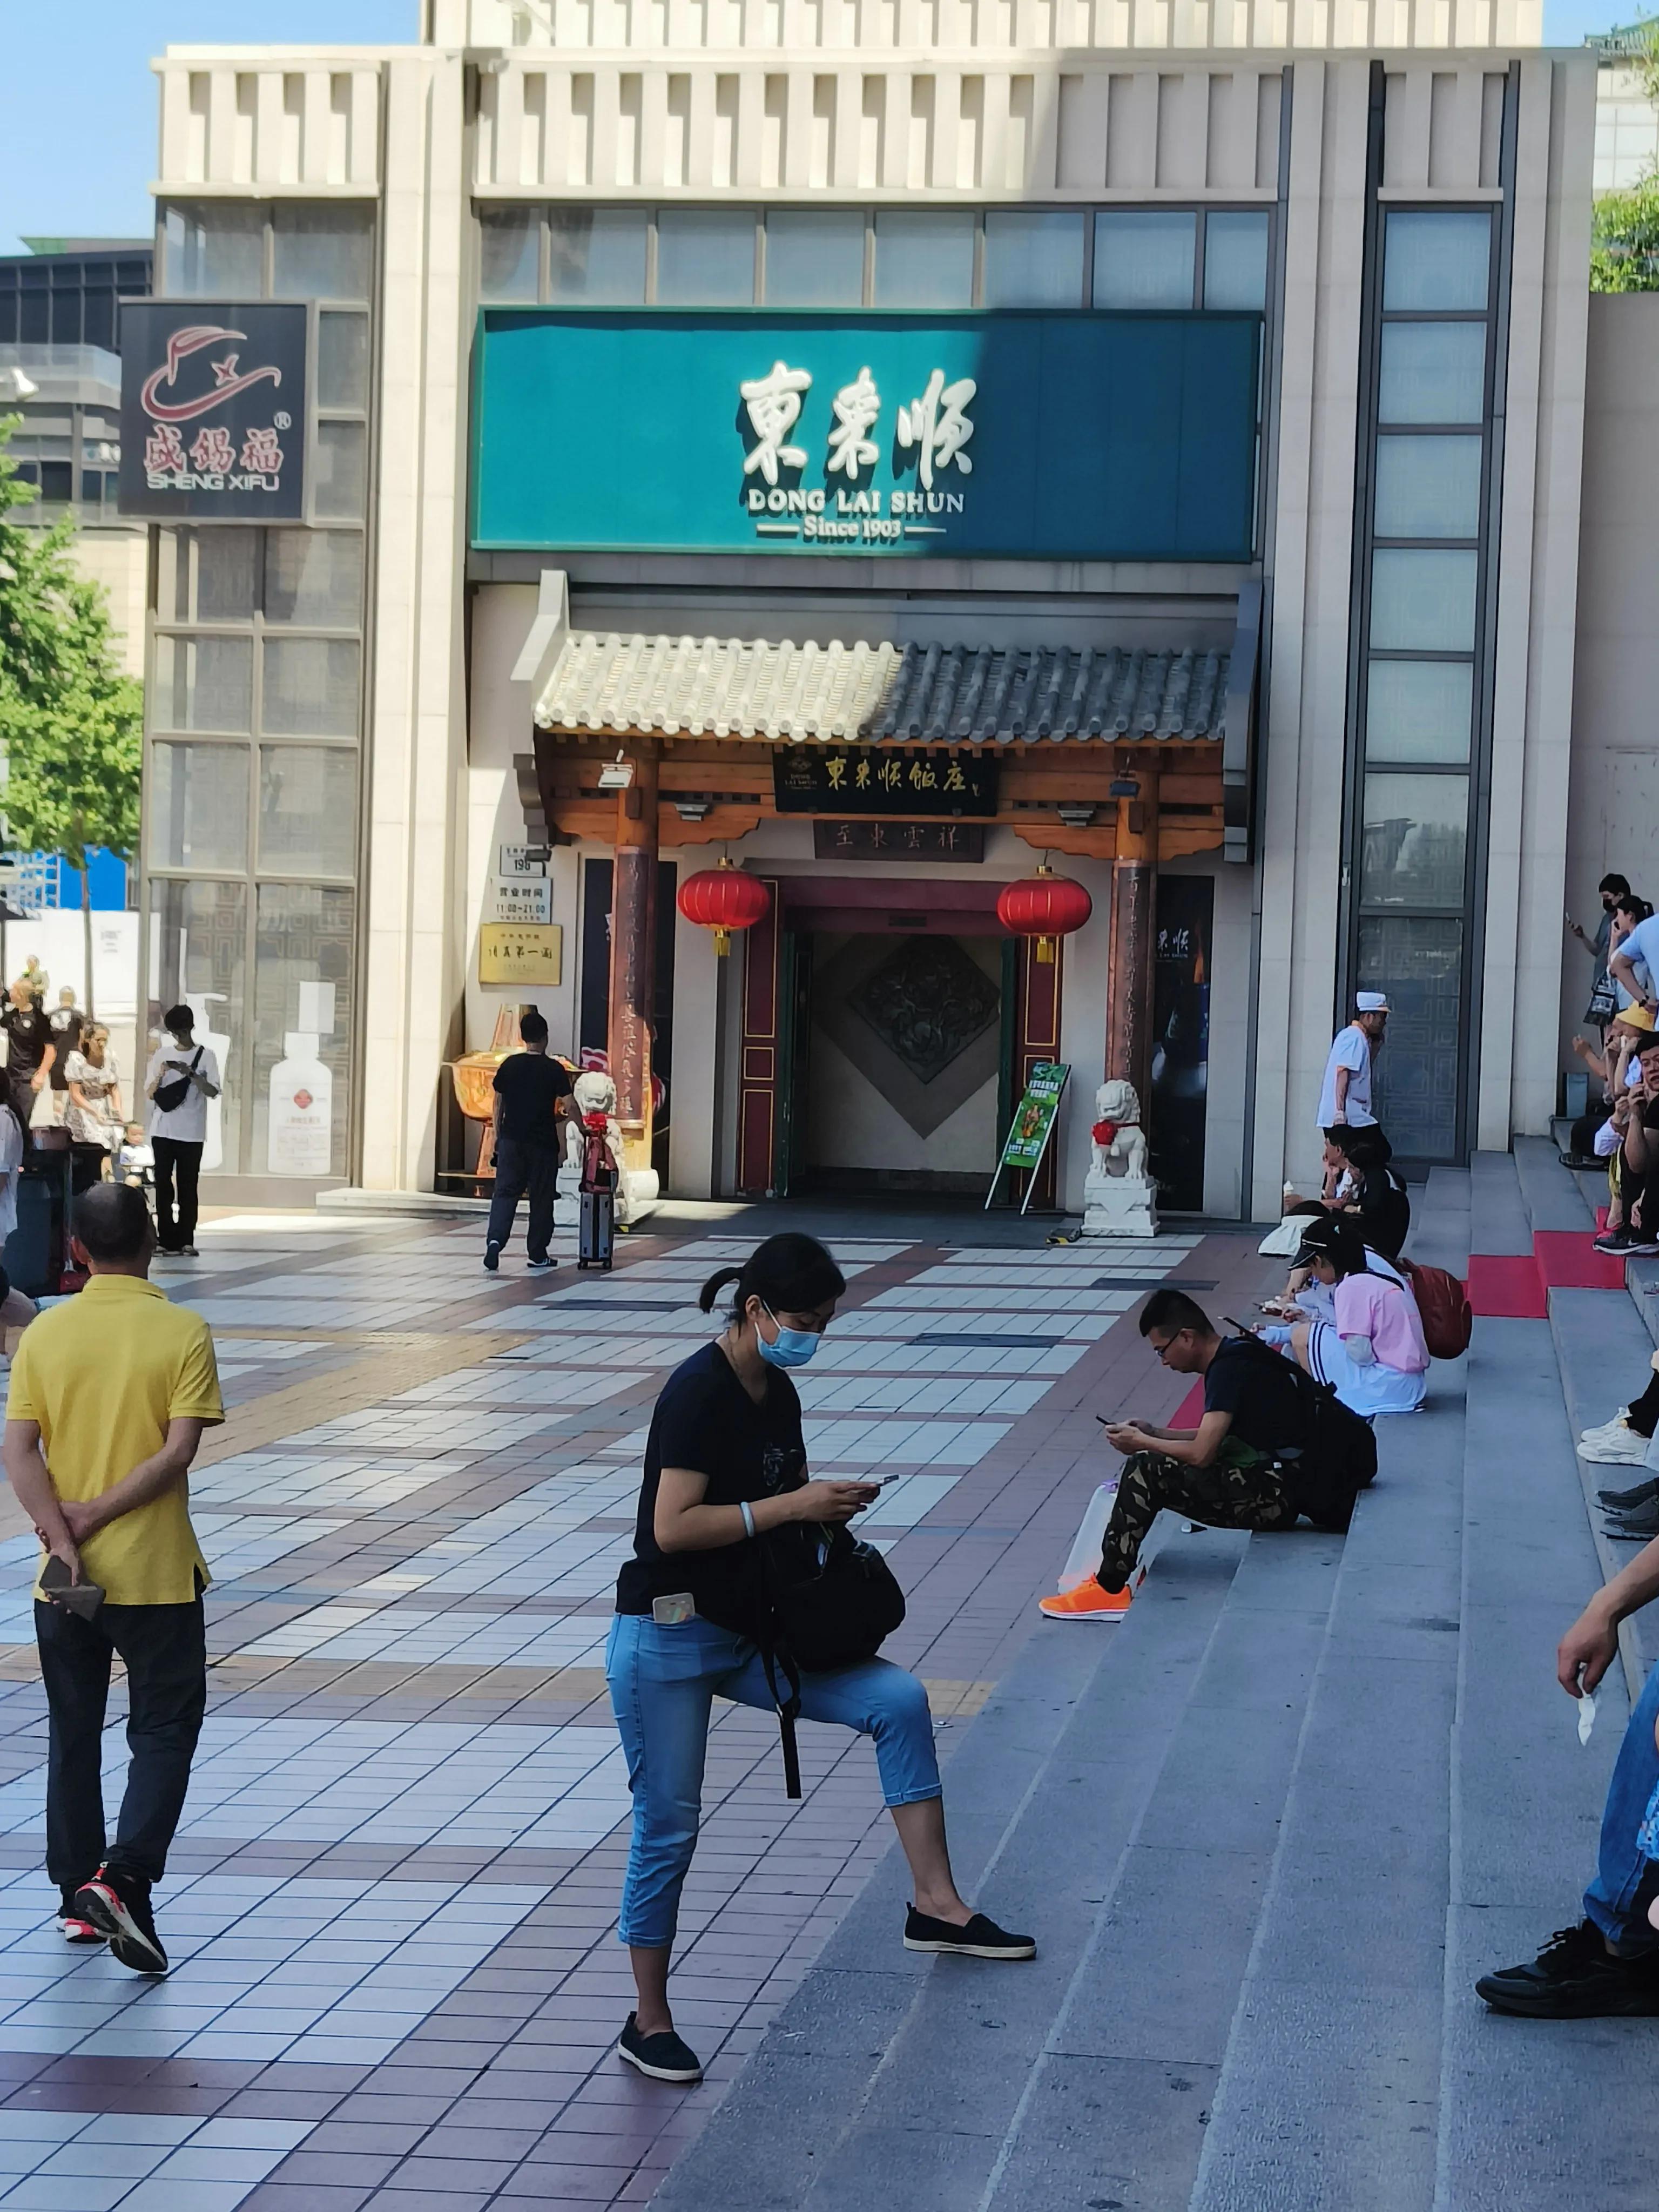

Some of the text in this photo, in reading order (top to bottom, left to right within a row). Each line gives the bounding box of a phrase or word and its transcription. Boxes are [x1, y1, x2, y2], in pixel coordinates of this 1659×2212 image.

[146, 474, 279, 491] SHENG XIFU
[748, 489, 964, 514] DONG LAI SHUN
[804, 515, 901, 538] Since 1903
